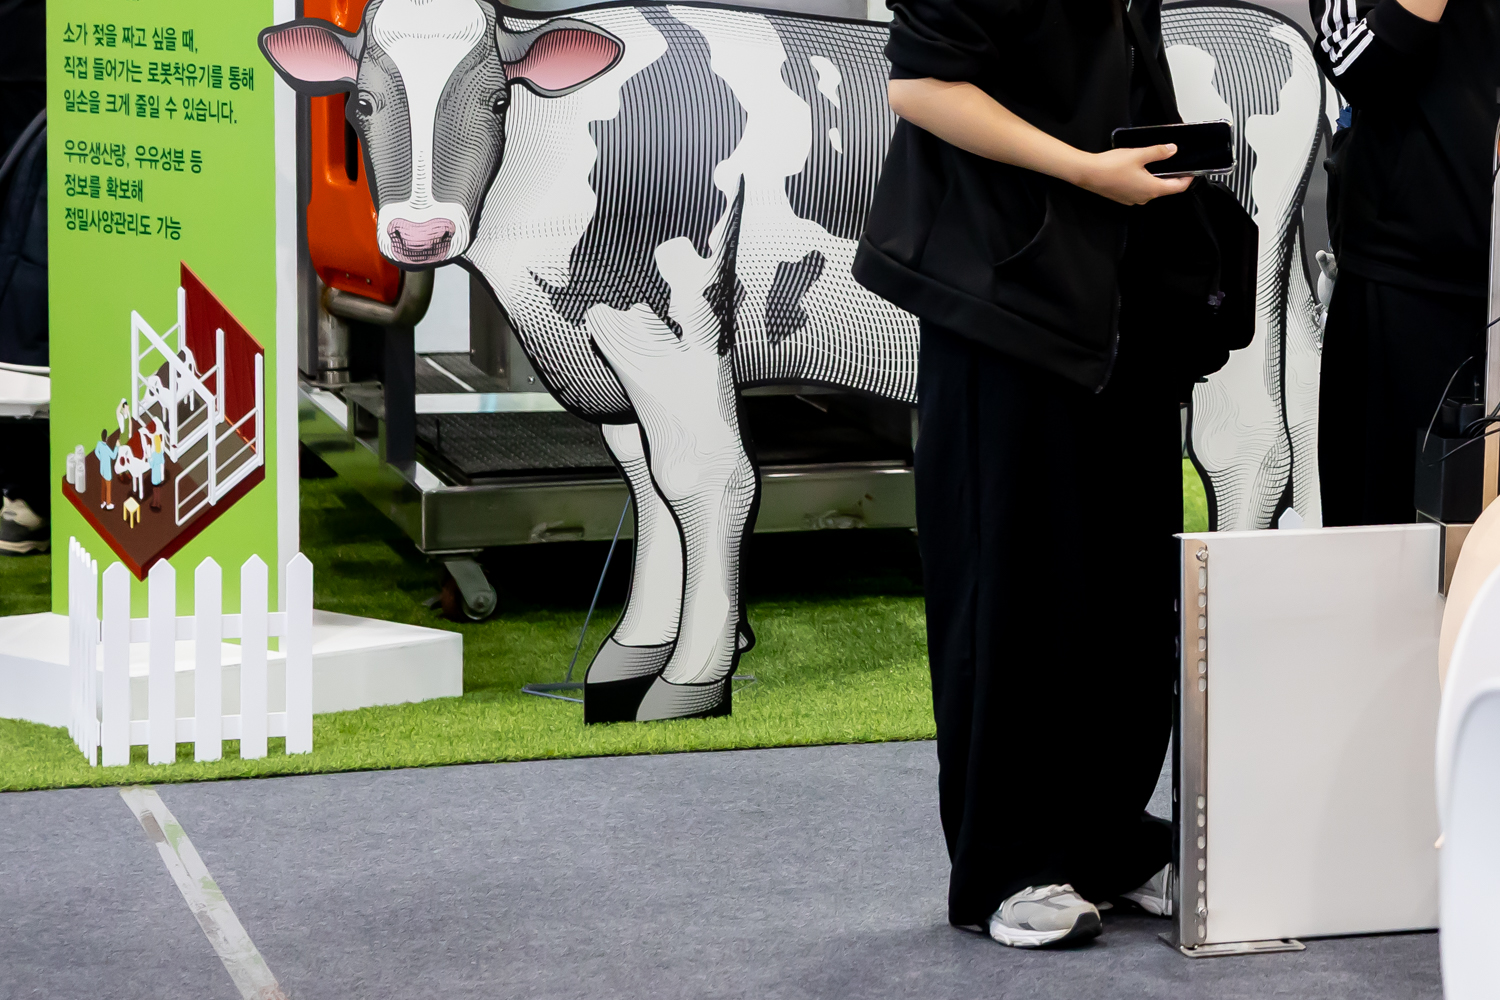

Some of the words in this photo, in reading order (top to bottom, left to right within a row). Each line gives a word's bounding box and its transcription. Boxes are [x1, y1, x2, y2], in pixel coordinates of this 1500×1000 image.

[62, 22, 88, 46] 소가
[92, 23, 118, 48] 젖을
[121, 25, 148, 49] 짜고
[151, 26, 178, 52] 싶을
[181, 28, 198, 54] 때,
[63, 55, 88, 80] 직접
[92, 57, 143, 84] 들어가는
[147, 61, 224, 90] 로봇착유기를
[227, 66, 255, 92] 통해
[63, 89, 101, 115] 일손을
[104, 92, 131, 117] 크게
[134, 94, 160, 119] 줄일
[164, 96, 178, 120] 수
[182, 97, 238, 125] 있습니다.
[63, 138, 130, 169] 우유생산량,
[134, 145, 186, 172] 우유성분
[189, 150, 203, 175] 등
[64, 173, 102, 199] 정보를
[105, 176, 144, 203] 확보해
[64, 207, 152, 237] 정밀사양관리도
[156, 215, 182, 241] 가능
